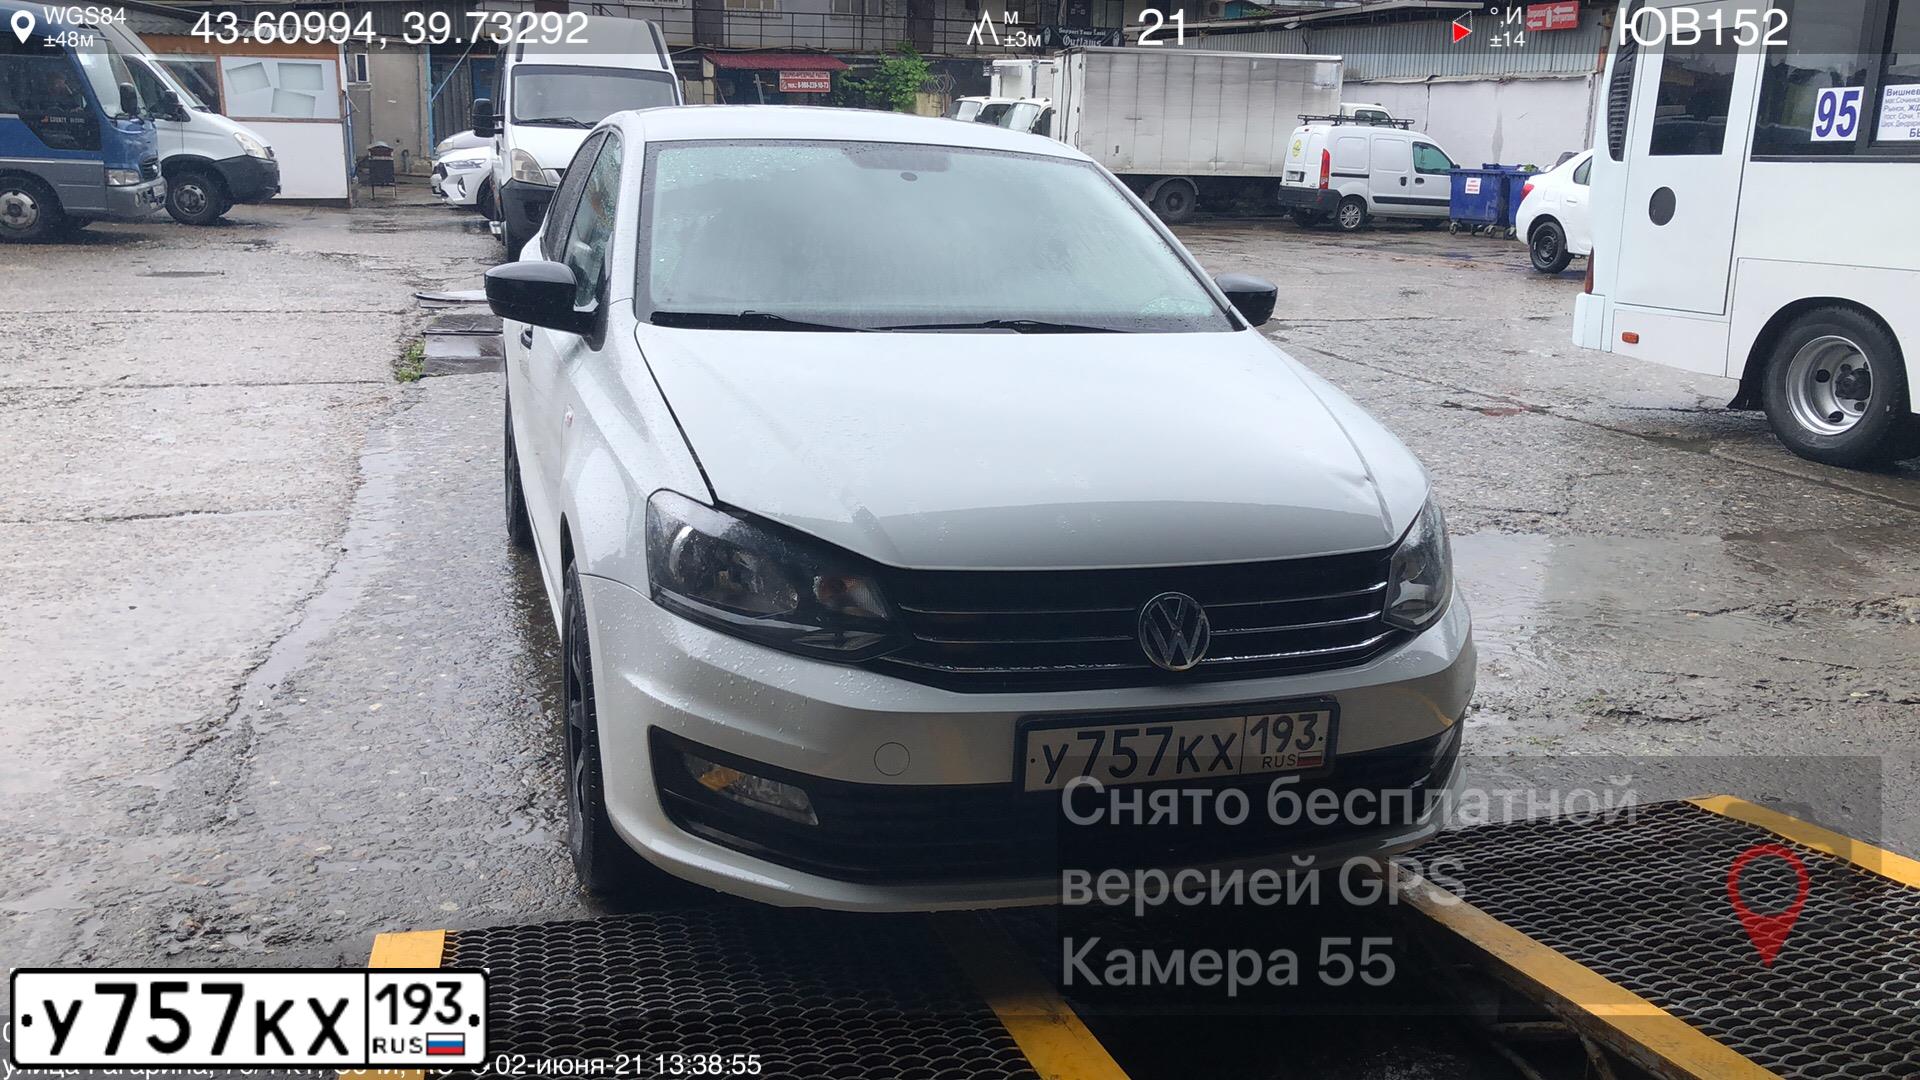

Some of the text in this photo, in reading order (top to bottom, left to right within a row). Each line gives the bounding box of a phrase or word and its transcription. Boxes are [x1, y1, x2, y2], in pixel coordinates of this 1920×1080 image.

[1063, 34, 1102, 48] Outlaws
[1815, 91, 1860, 137] 95
[1250, 713, 1319, 756] 193
[1261, 753, 1297, 770] RUS
